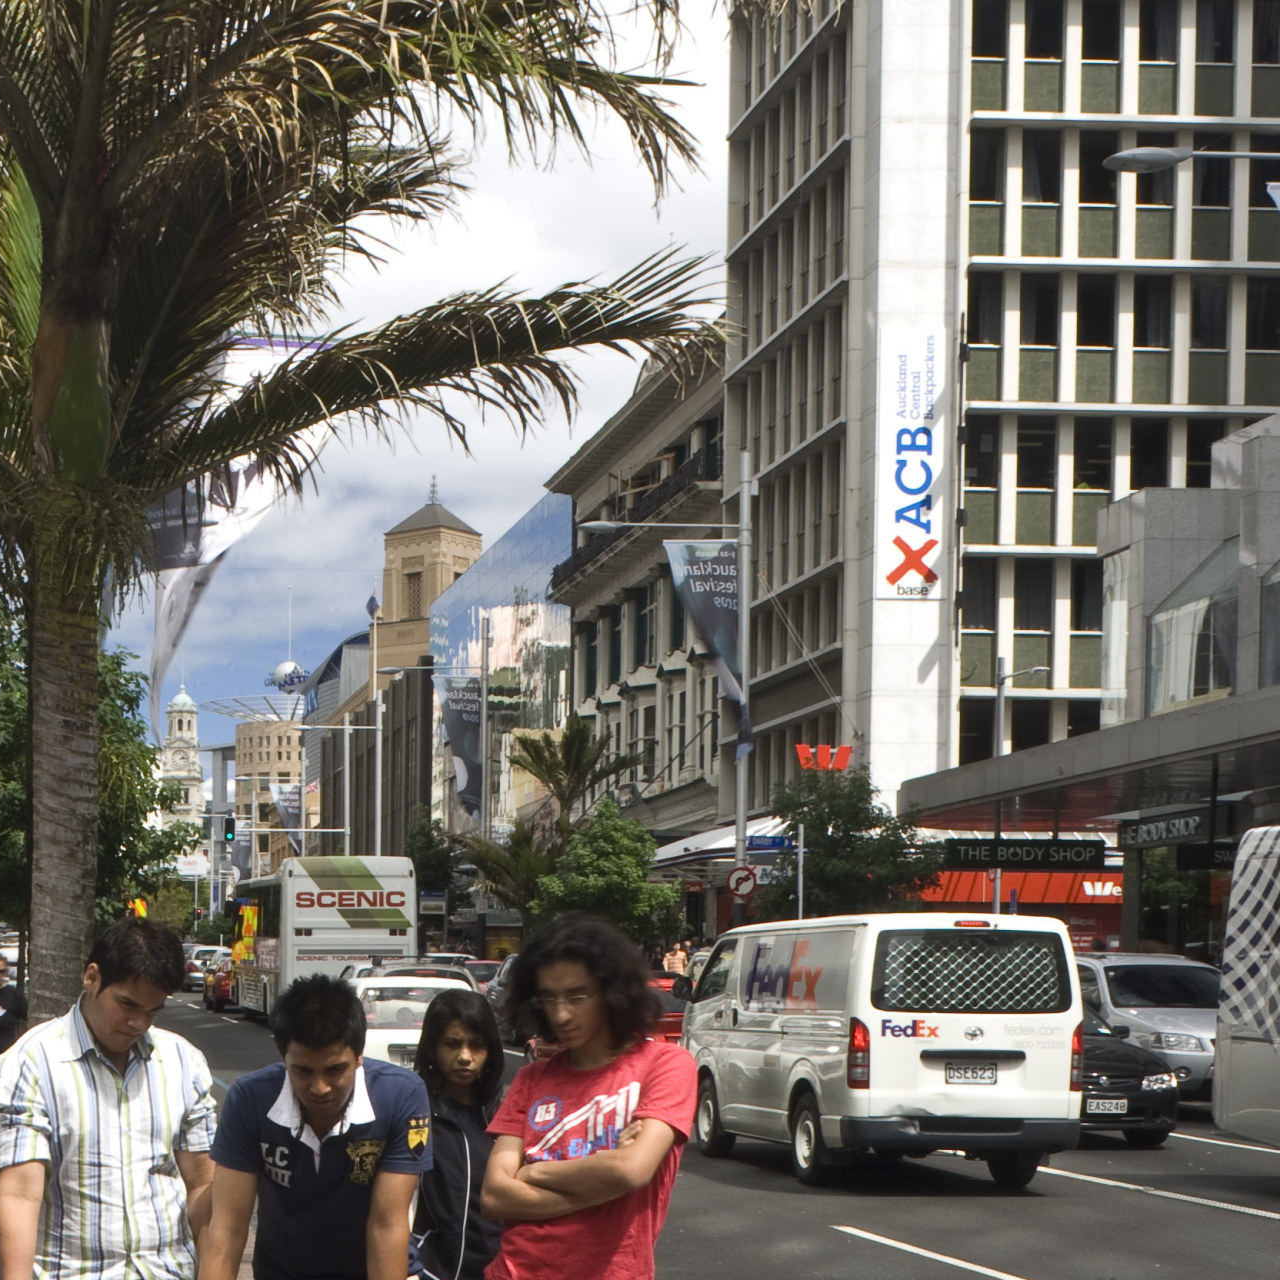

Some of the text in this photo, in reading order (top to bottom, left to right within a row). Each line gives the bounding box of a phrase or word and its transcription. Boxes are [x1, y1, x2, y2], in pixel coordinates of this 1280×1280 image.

[896, 353, 908, 419] Auckland
[923, 334, 936, 421] Backpackers
[910, 370, 921, 420] Central
[894, 425, 933, 535] ACB
[896, 583, 929, 596] base
[1137, 823, 1169, 844] BODY
[958, 845, 1096, 862] THE BODY SHOP
[296, 891, 406, 908] SCENIC
[881, 1020, 939, 1038] FedEx
[1004, 1023, 1064, 1037] fedex.com
[947, 1065, 995, 1081] DSE623
[1088, 1100, 1127, 1113] EAS240
